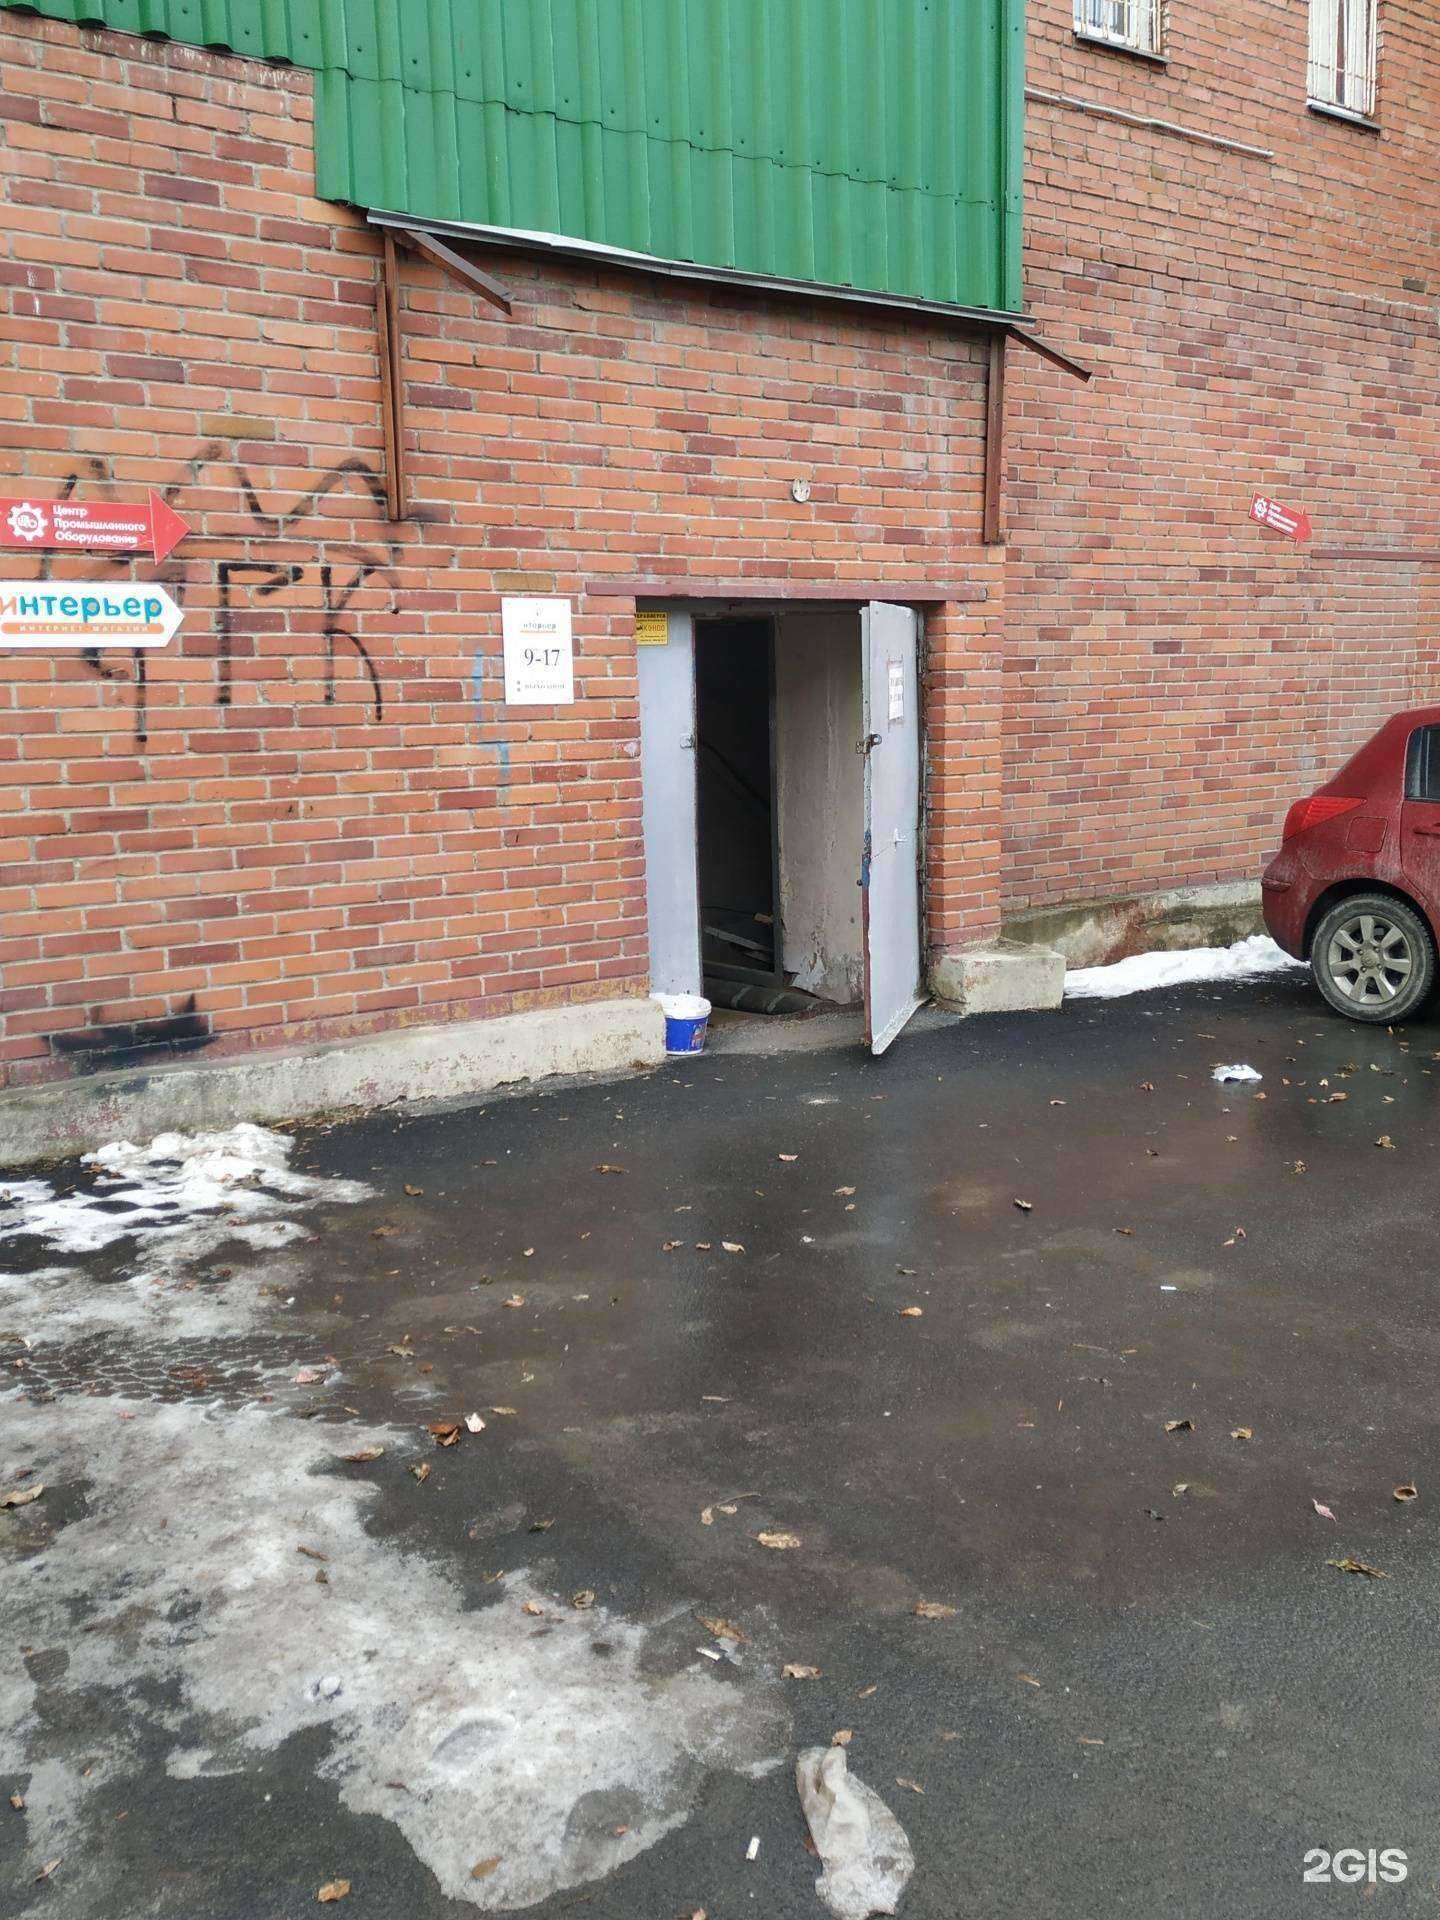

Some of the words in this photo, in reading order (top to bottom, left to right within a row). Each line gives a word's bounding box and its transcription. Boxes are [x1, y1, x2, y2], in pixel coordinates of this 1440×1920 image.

[52, 504, 88, 518] Центр
[53, 517, 146, 533] Промышленного
[55, 531, 138, 545] Оборудования
[0, 596, 163, 624] интерьер
[524, 648, 560, 667] 9-17
